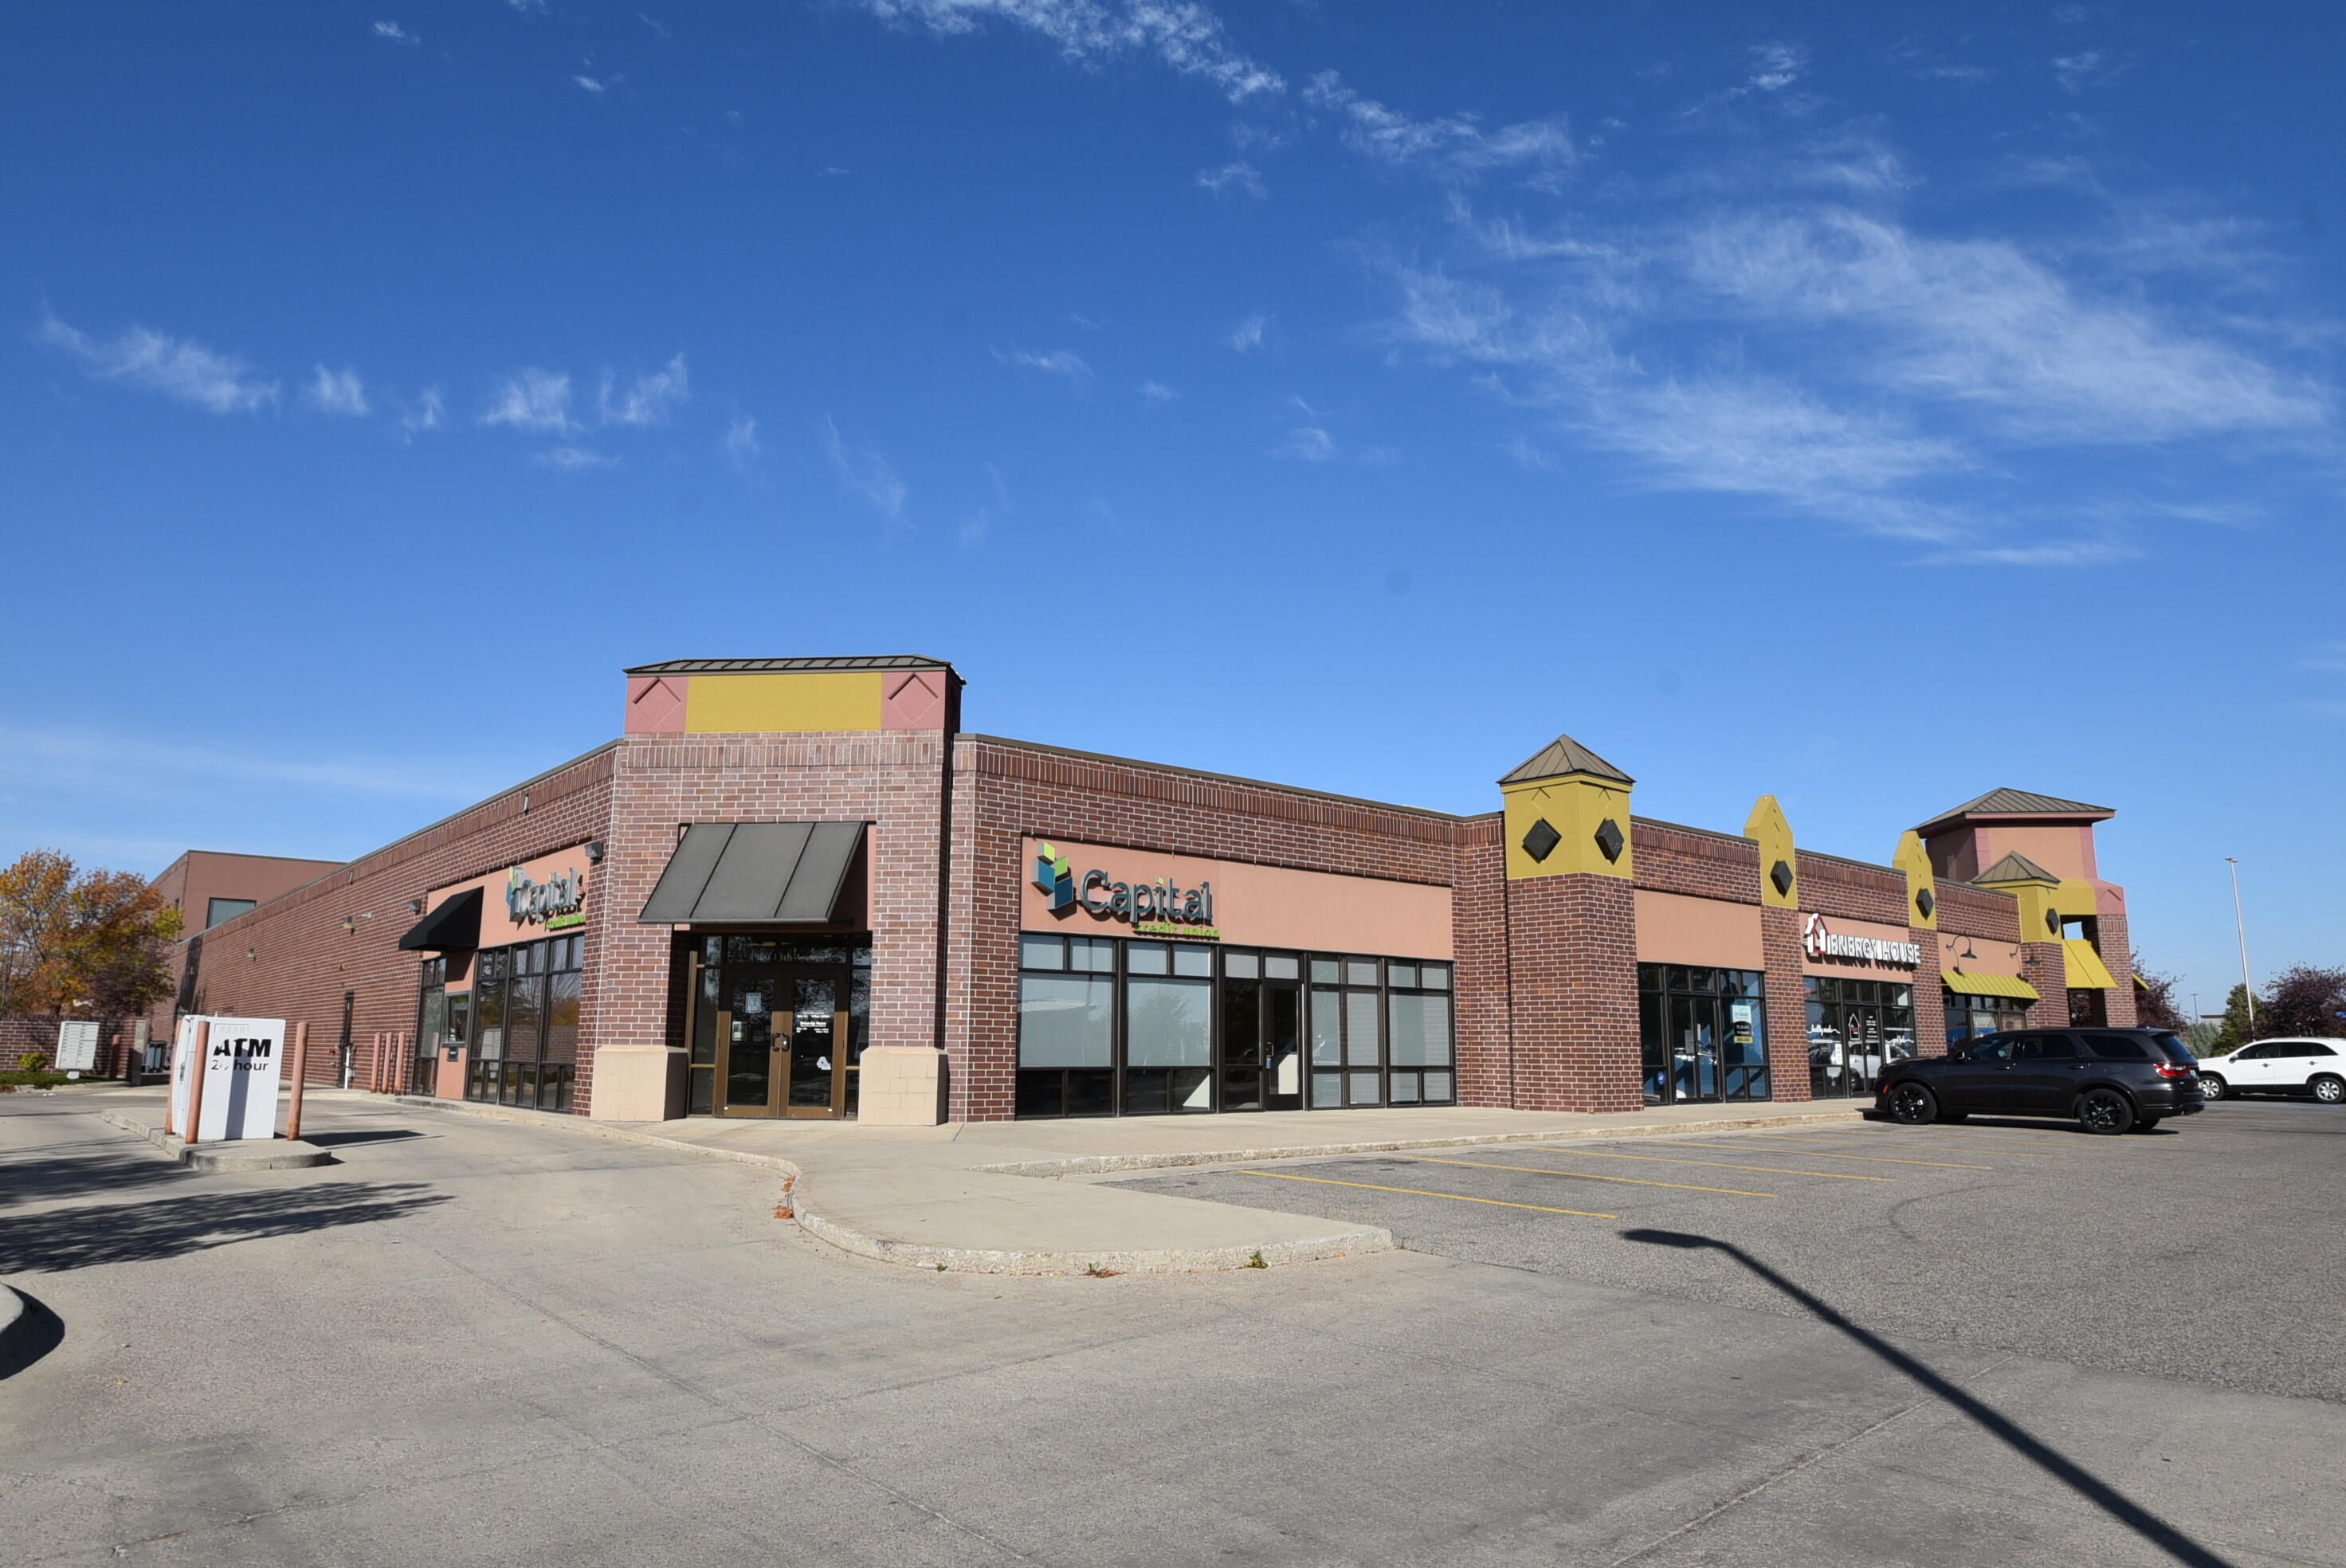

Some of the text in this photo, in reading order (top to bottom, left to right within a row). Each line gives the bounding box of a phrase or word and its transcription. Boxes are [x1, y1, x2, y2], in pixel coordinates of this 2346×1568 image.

[1081, 869, 1213, 923] Capital
[1134, 921, 1220, 937] credit union
[1827, 934, 1921, 963] ENERGY HOUSE
[213, 1038, 272, 1057] ATM
[233, 1058, 269, 1071] hour
